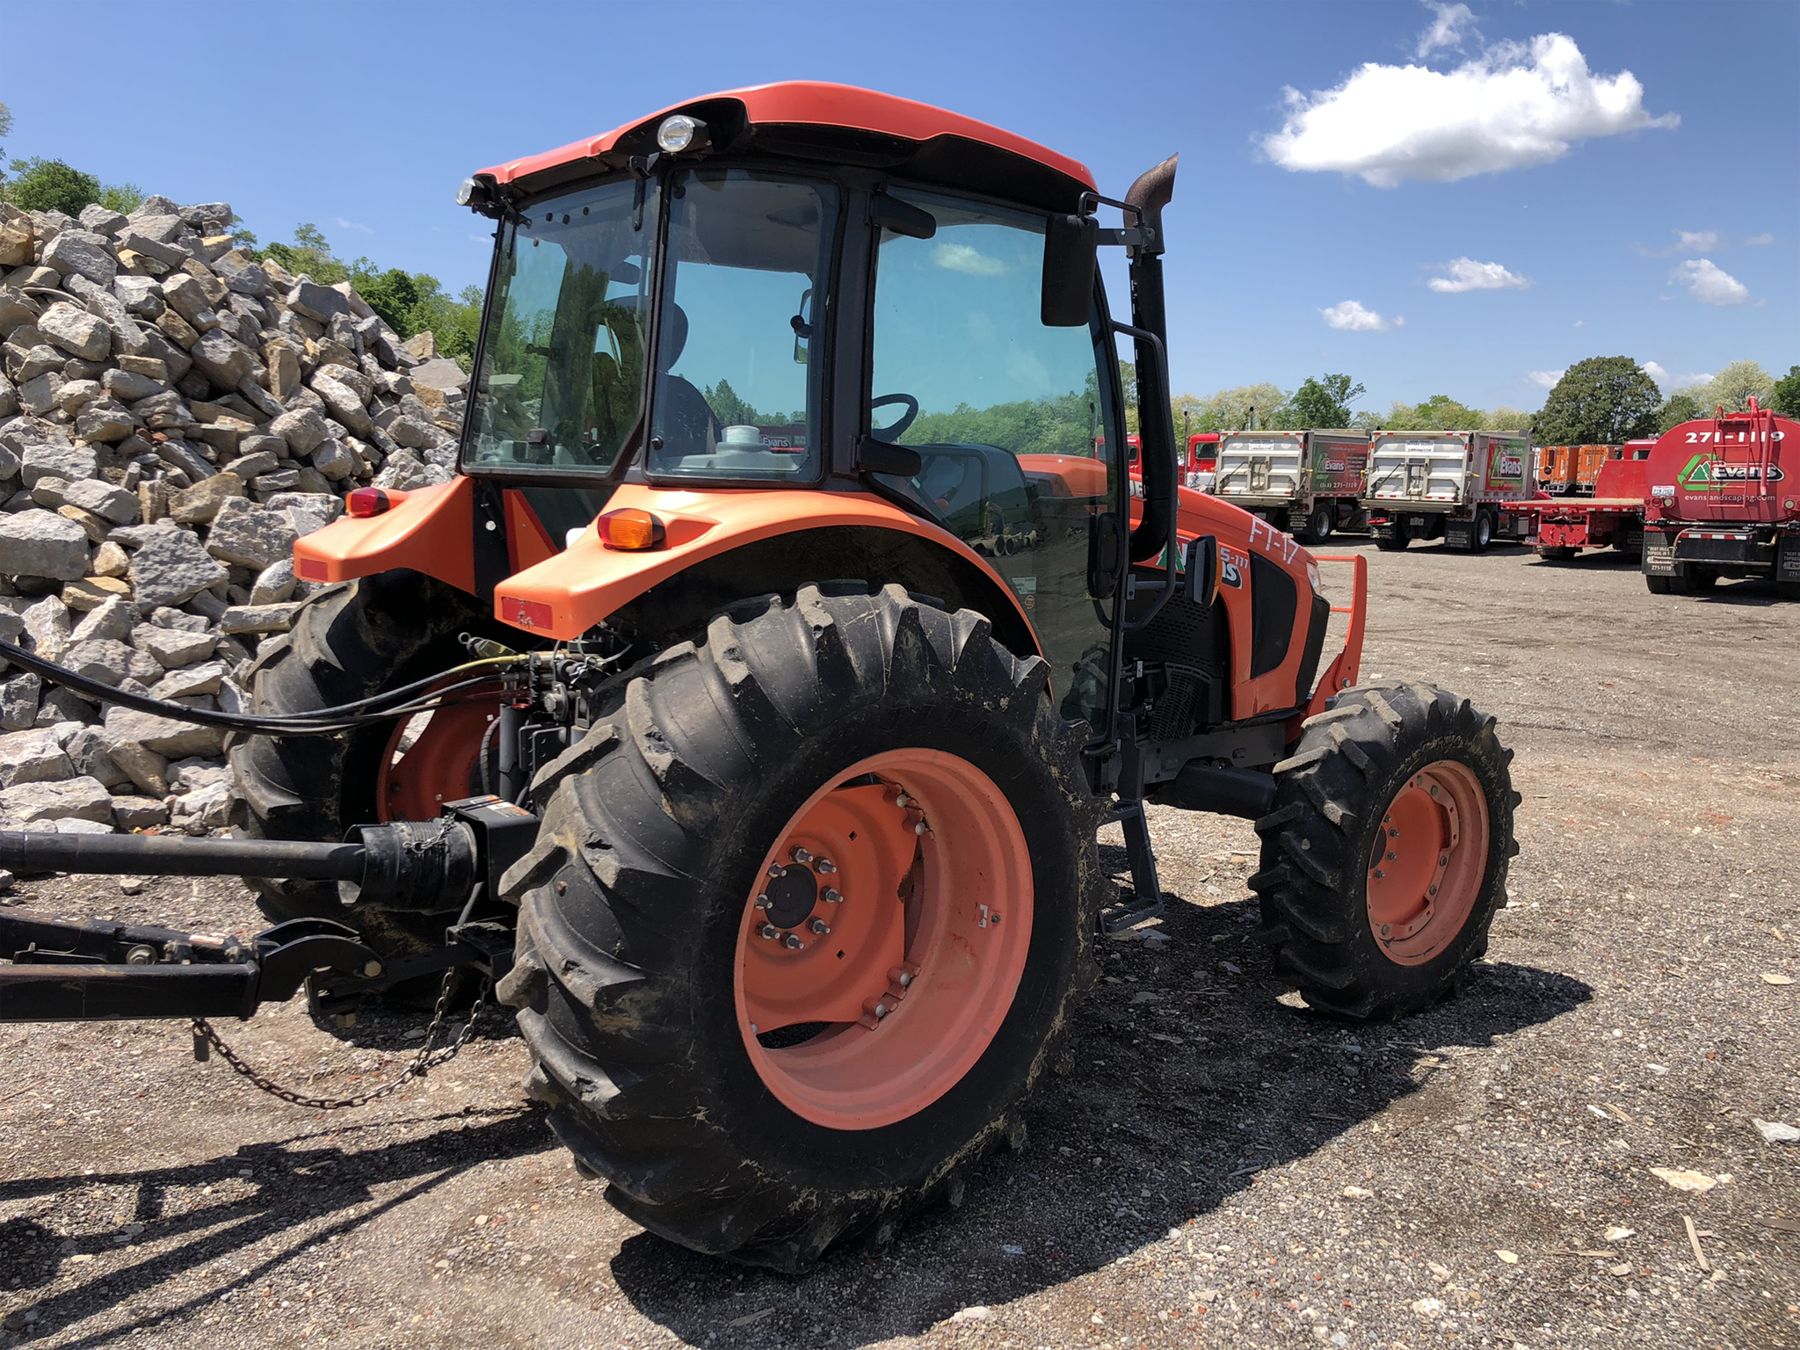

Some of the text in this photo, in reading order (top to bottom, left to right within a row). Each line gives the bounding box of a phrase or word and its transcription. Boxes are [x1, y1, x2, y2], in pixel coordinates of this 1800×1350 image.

[763, 437, 788, 446] Evans
[1685, 431, 1785, 443] 271-1119
[1501, 458, 1520, 474] Evans
[1712, 464, 1777, 478] Evans
[1684, 493, 1776, 503] evansandscapng.com
[1249, 516, 1300, 565] FT-17
